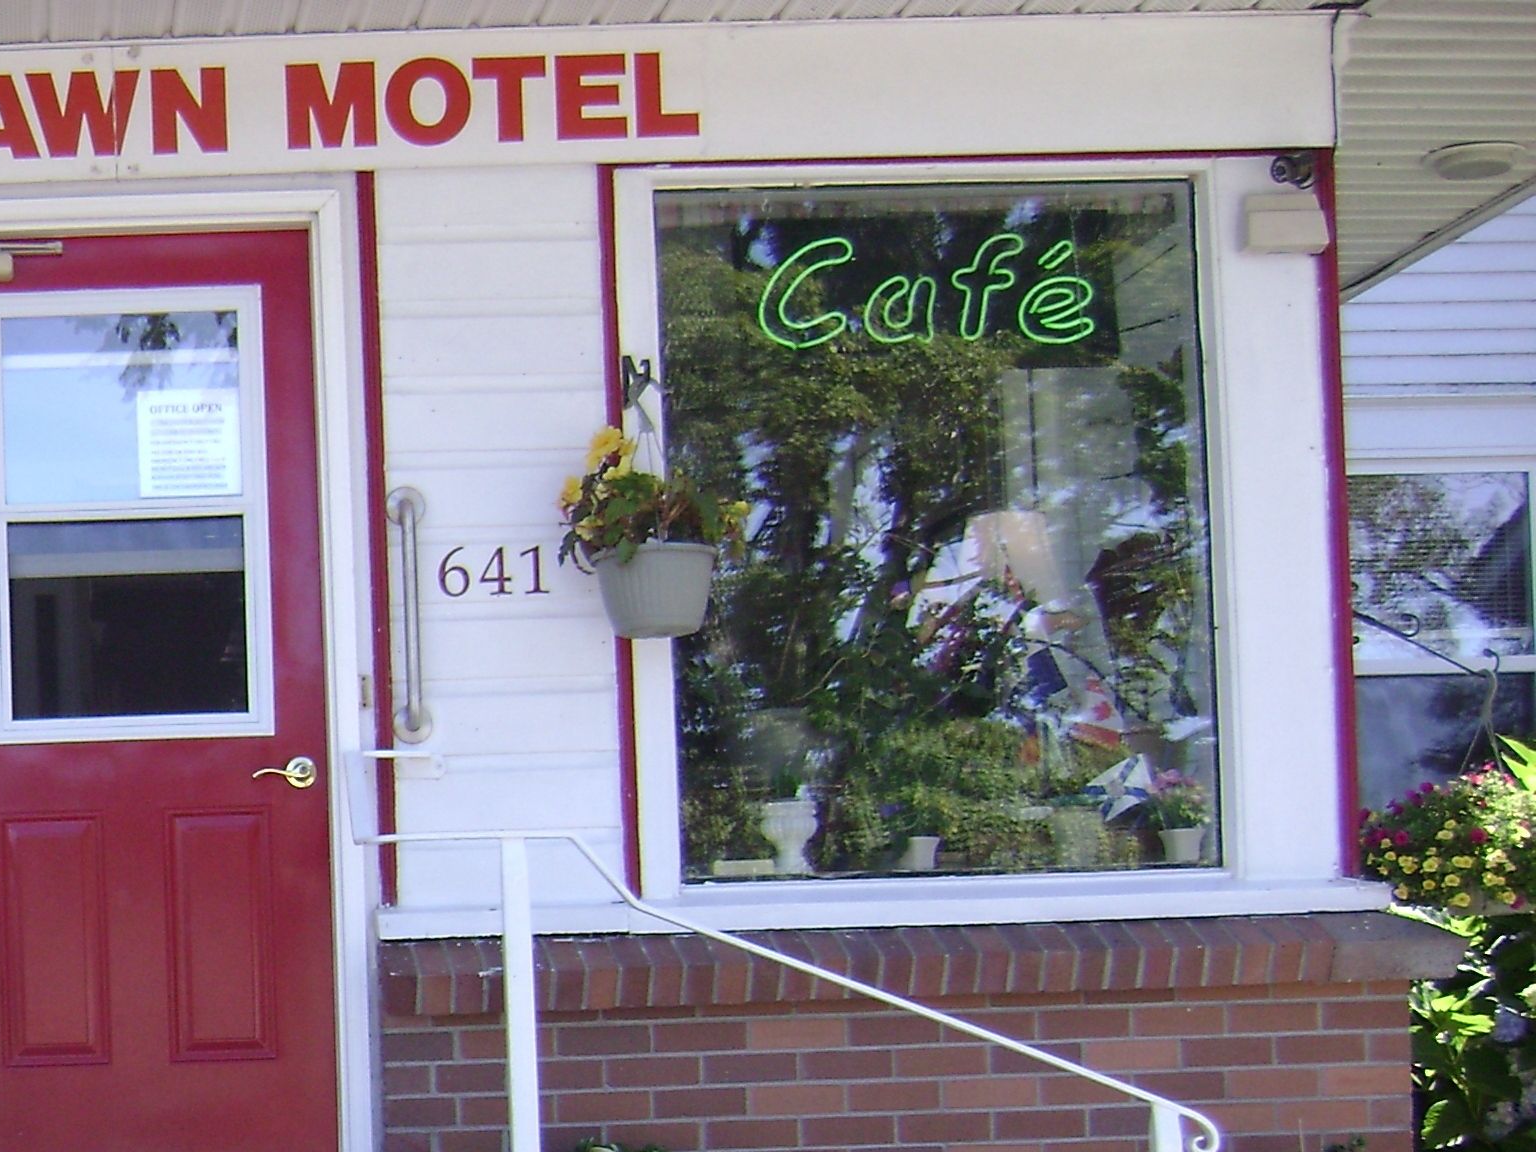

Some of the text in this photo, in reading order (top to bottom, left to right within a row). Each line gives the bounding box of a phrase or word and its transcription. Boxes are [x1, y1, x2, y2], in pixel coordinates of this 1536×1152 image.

[285, 52, 700, 148] MOTEL
[759, 233, 1096, 350] Café
[149, 402, 222, 414] OFFICE OPEN
[438, 545, 550, 597] 641
